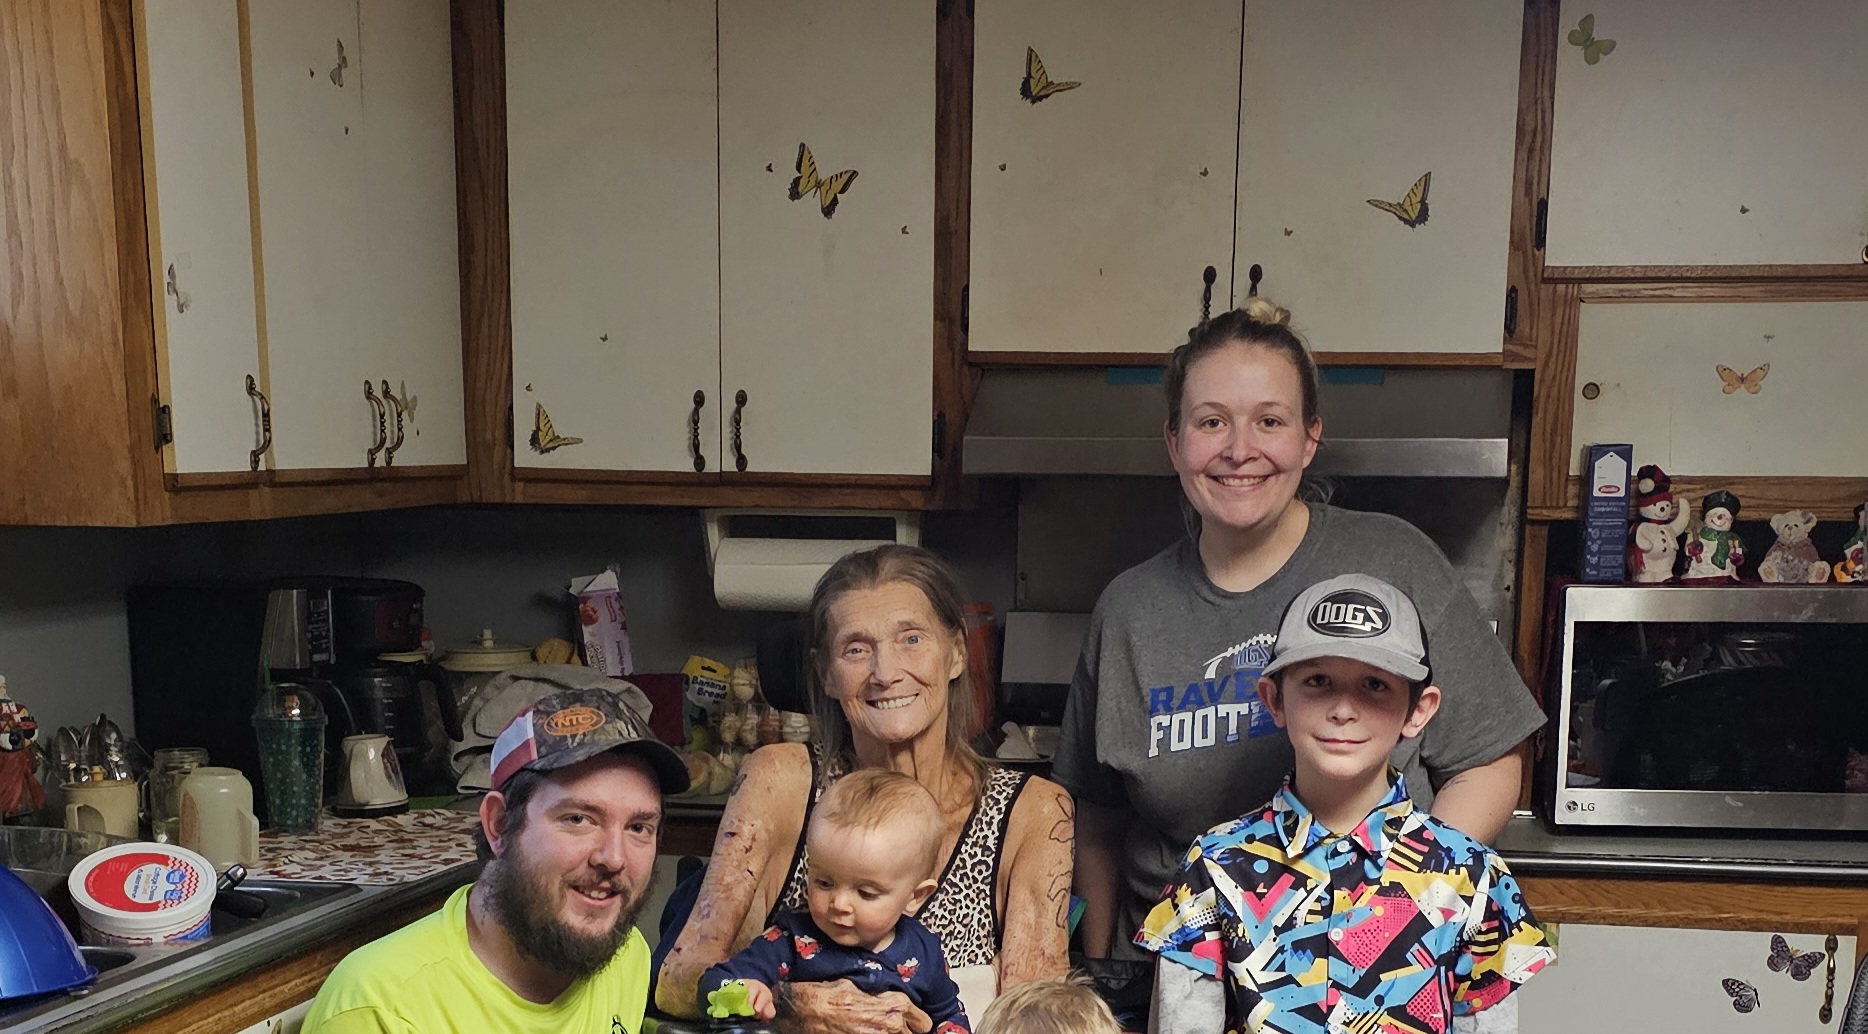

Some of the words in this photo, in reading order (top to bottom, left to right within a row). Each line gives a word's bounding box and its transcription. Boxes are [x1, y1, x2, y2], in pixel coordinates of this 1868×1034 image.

[1316, 601, 1383, 631] DOGS
[691, 676, 727, 691] Banana
[697, 686, 728, 700] Bread
[1149, 670, 1262, 715] RAVE
[1581, 803, 1595, 811] LG
